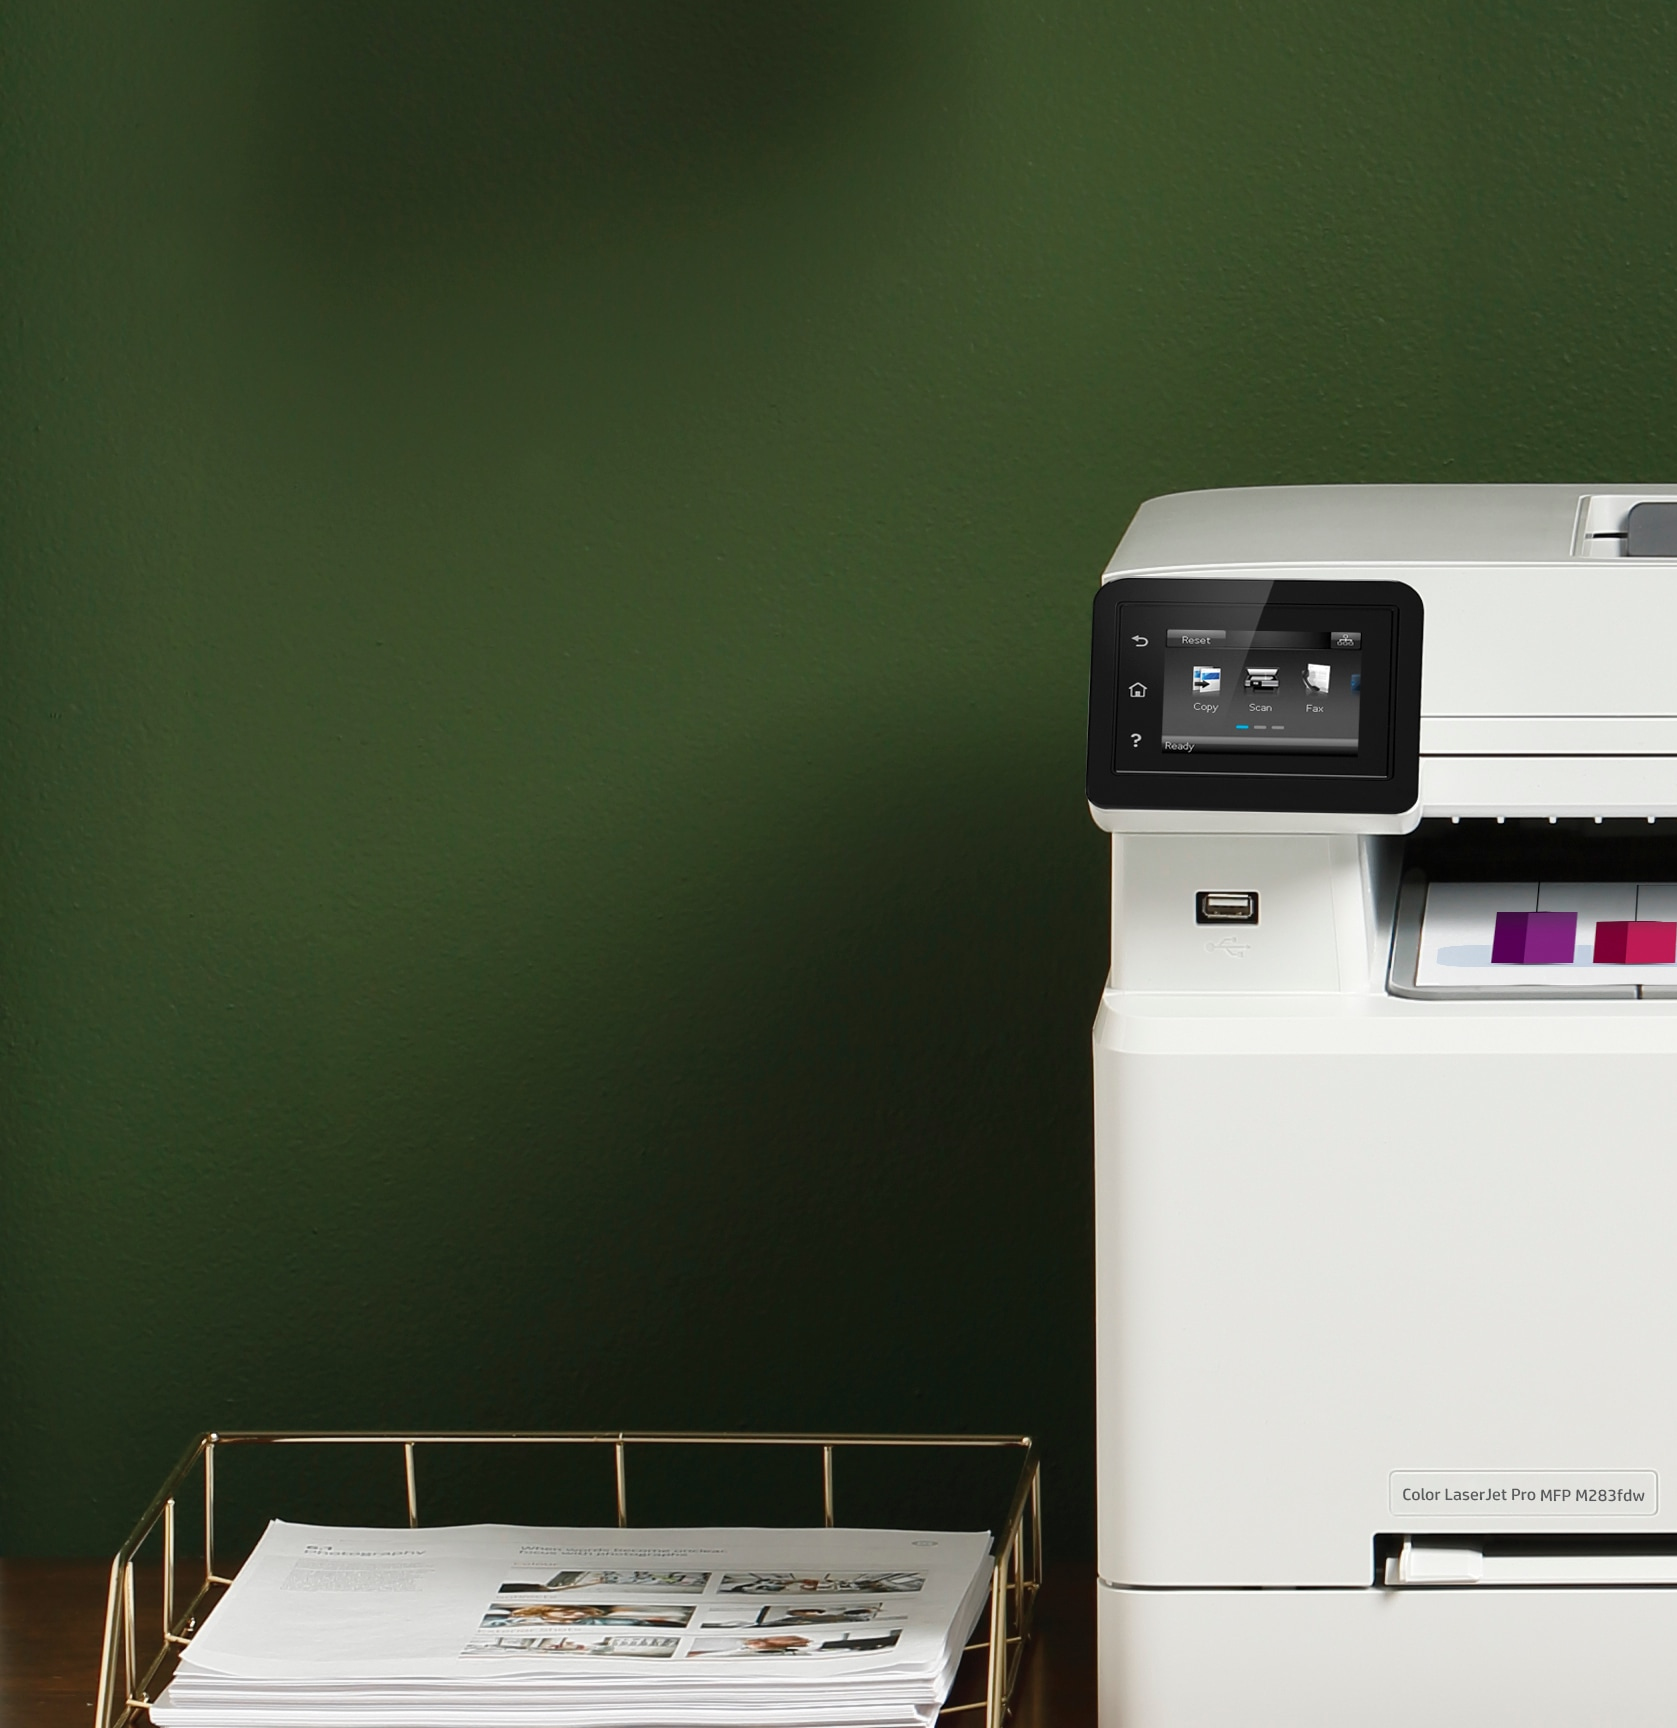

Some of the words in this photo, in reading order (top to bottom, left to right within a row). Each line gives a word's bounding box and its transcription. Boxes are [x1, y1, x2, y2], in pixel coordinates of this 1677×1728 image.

[1182, 636, 1211, 645] Reset
[1193, 703, 1219, 713] Copy
[1249, 704, 1273, 712] Scan
[1306, 705, 1324, 713] Fax
[1165, 742, 1195, 753] Ready
[1402, 1488, 1441, 1501] Color
[1445, 1488, 1507, 1501] LaserJet
[1511, 1489, 1536, 1501] Pro
[1540, 1489, 1571, 1502] MFP
[1575, 1489, 1645, 1502] M283fdw
